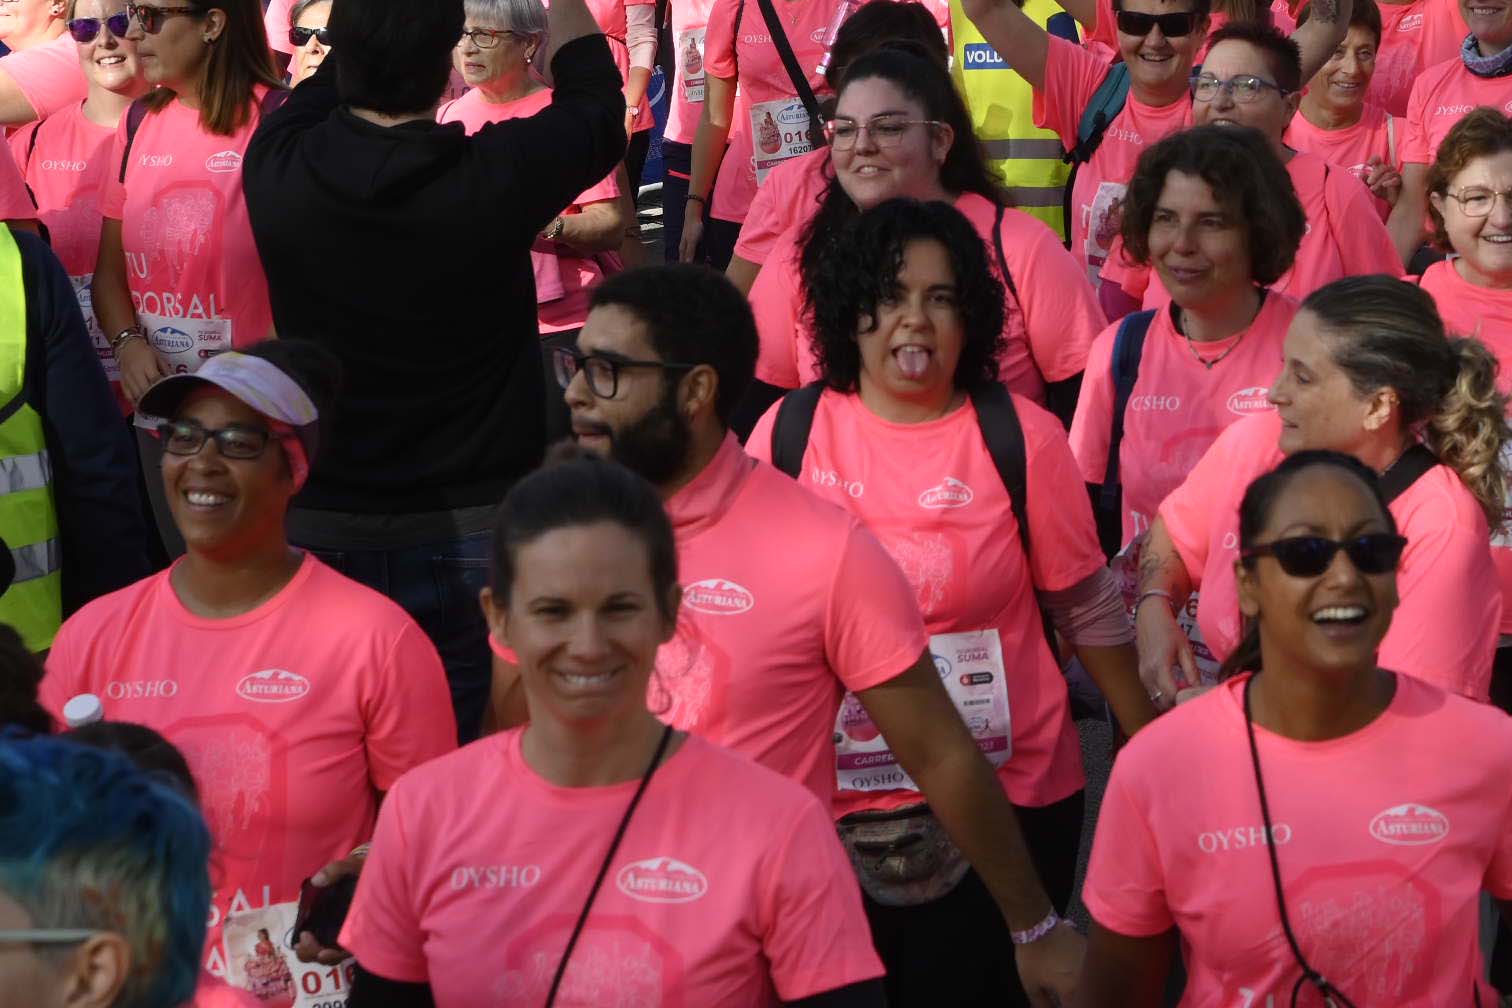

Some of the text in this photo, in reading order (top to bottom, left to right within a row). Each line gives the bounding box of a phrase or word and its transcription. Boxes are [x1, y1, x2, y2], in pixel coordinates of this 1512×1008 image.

[41, 158, 87, 171] OYSHO
[689, 590, 748, 608] ASTURIANA
[956, 652, 990, 663] SUMA
[107, 679, 178, 700] OYSHO
[244, 681, 306, 695] ASTURIANA
[851, 771, 905, 790] OYSHO
[1379, 818, 1443, 836] ASTURIANA
[1198, 822, 1292, 854] OYSHO
[451, 864, 542, 892] OYSHO
[628, 872, 700, 894] ASTURIANA
